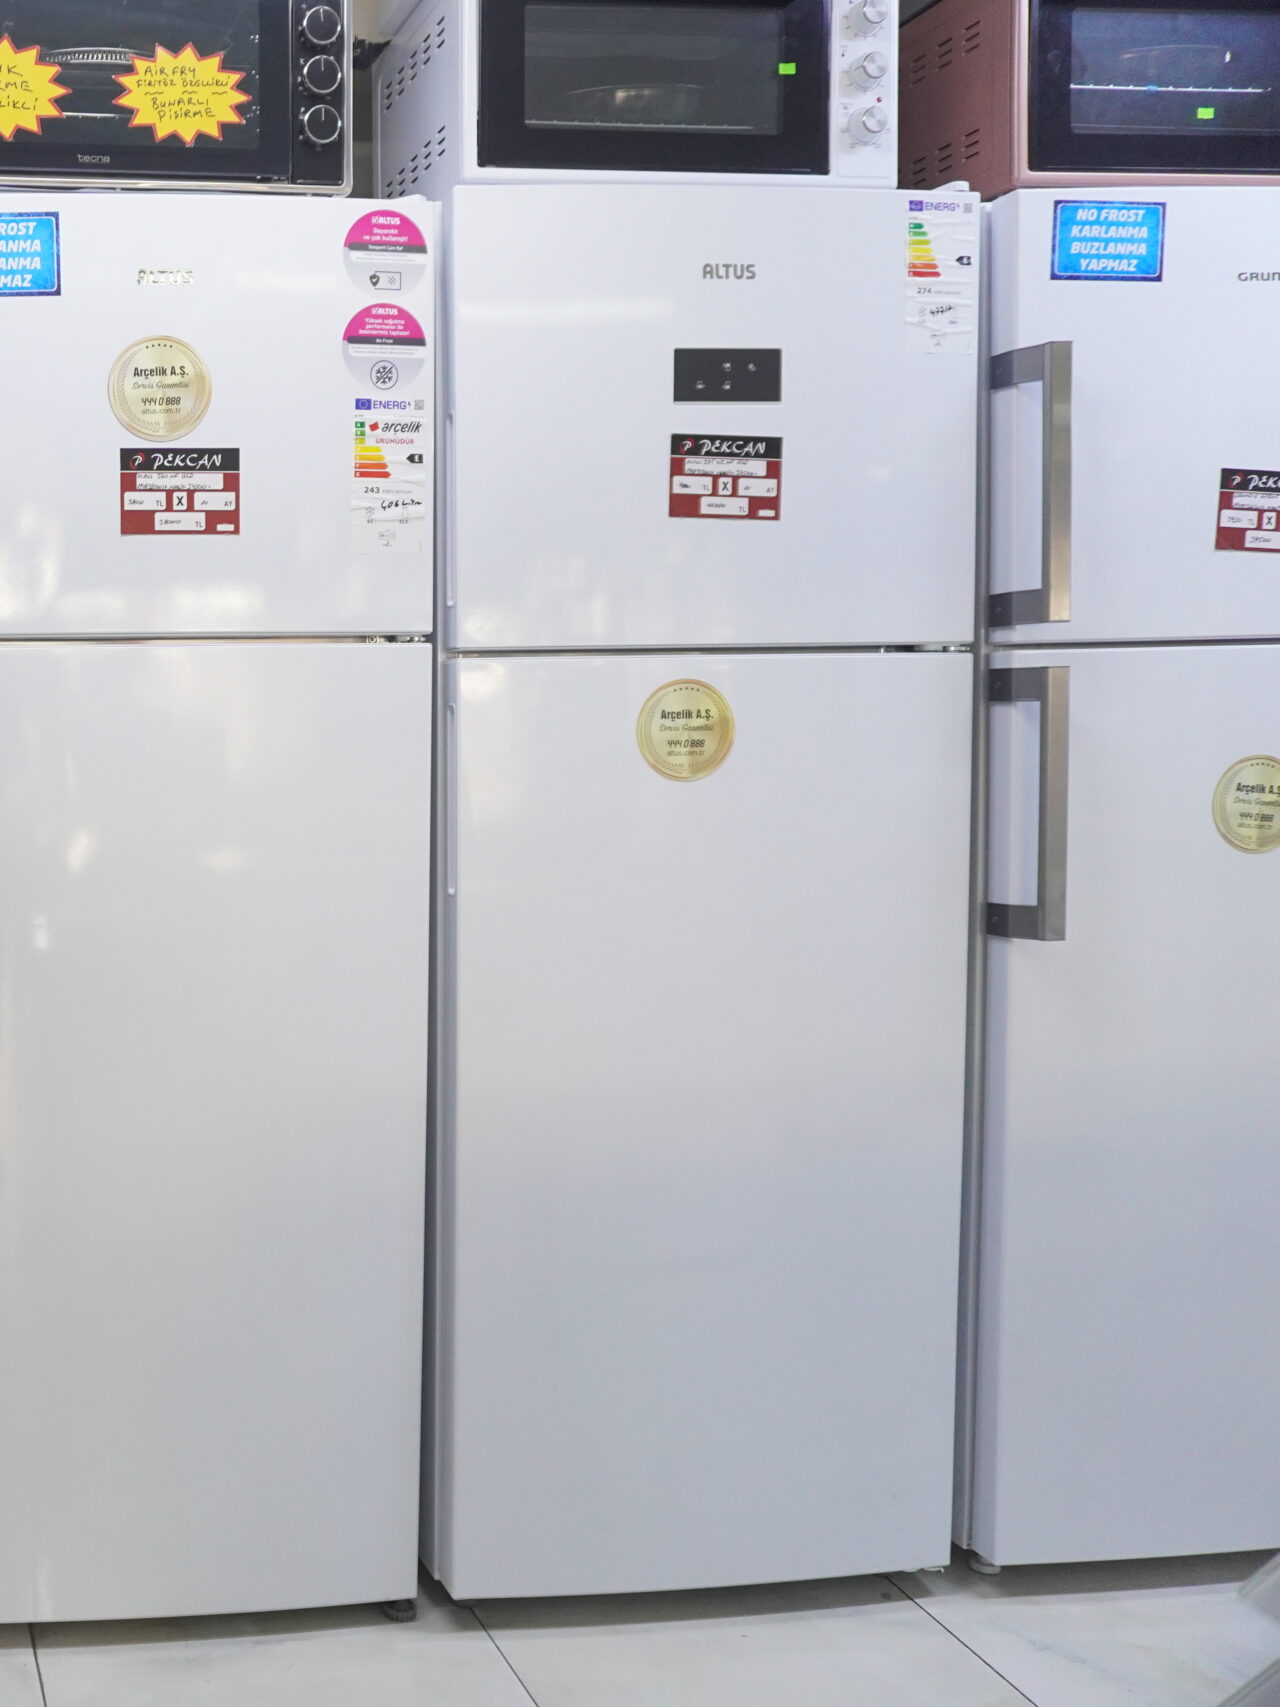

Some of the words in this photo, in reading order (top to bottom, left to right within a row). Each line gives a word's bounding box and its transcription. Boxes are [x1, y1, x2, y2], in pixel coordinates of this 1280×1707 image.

[172, 66, 196, 77] FRY
[379, 216, 400, 225] ALTUS
[1076, 208, 1098, 221] NO
[1100, 209, 1146, 222] FROST
[1070, 225, 1148, 238] KARLANMA
[1070, 242, 1147, 255] BUZLANMA
[1080, 258, 1138, 271] YAPMAZ
[137, 269, 194, 285] ALTUS
[703, 263, 756, 280] ALTUS
[378, 307, 398, 315] ALTUS
[133, 366, 167, 379] Arçelik
[170, 365, 189, 378] A.Ş.
[132, 382, 154, 390] Servis
[141, 397, 157, 406] 444
[165, 396, 181, 405] 888
[373, 400, 407, 410] ENERG
[141, 407, 181, 415] altus.com.tr
[381, 421, 422, 435] arçelik
[698, 440, 766, 456] PEKCAN
[151, 453, 222, 470] PEKCAN
[414, 454, 421, 462] E
[721, 481, 729, 491] X
[1247, 474, 1280, 490] PEK
[364, 486, 380, 494] 243
[176, 496, 184, 507] X
[1265, 516, 1273, 525] X
[661, 709, 693, 722] Arçelik
[696, 708, 714, 721] A.Ş.
[667, 740, 682, 748] 444
[690, 739, 705, 748] 888
[1236, 783, 1266, 795] Arçelik
